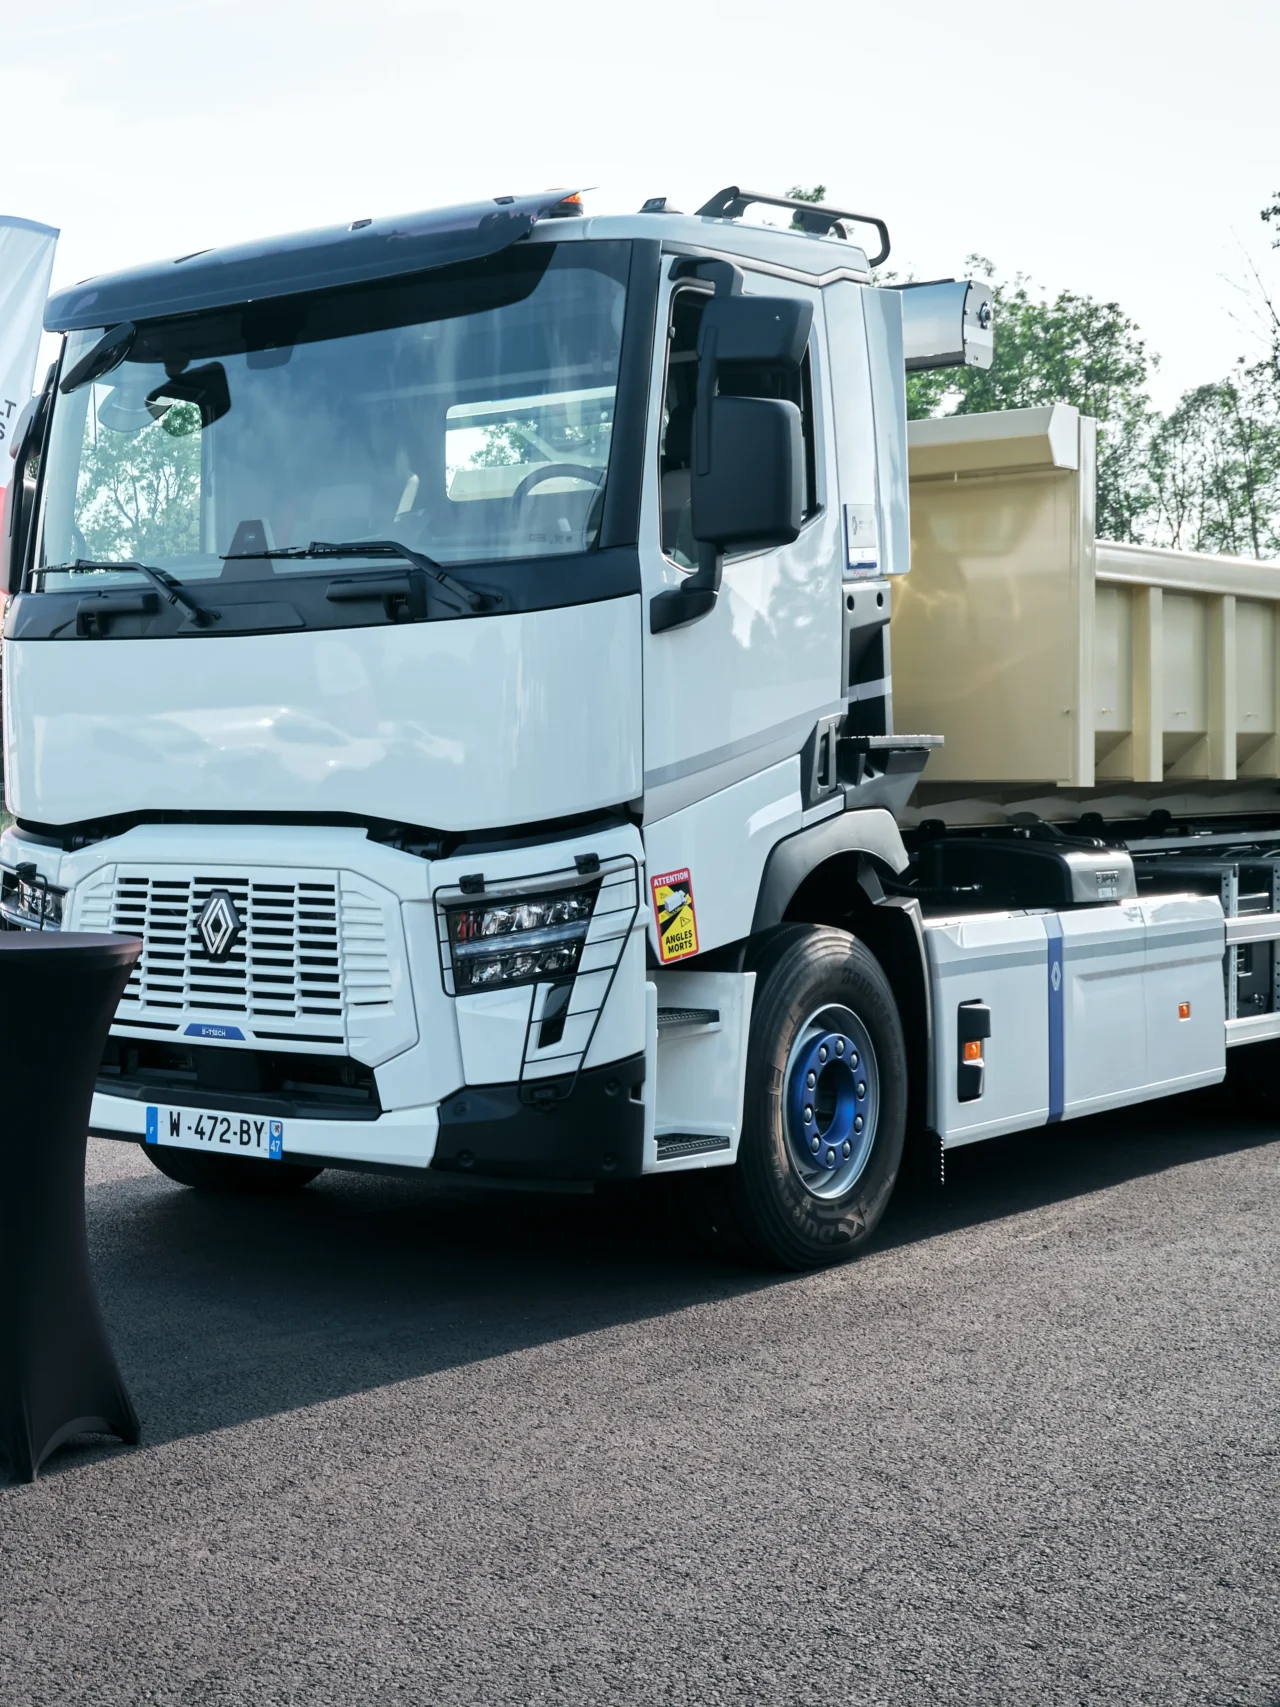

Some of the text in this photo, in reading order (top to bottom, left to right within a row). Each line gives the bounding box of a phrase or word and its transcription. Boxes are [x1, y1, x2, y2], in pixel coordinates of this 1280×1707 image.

[653, 870, 689, 887] ATTENTION
[665, 929, 693, 945] ANGLES
[668, 939, 693, 954] MORTS
[270, 1140, 281, 1153] 47
